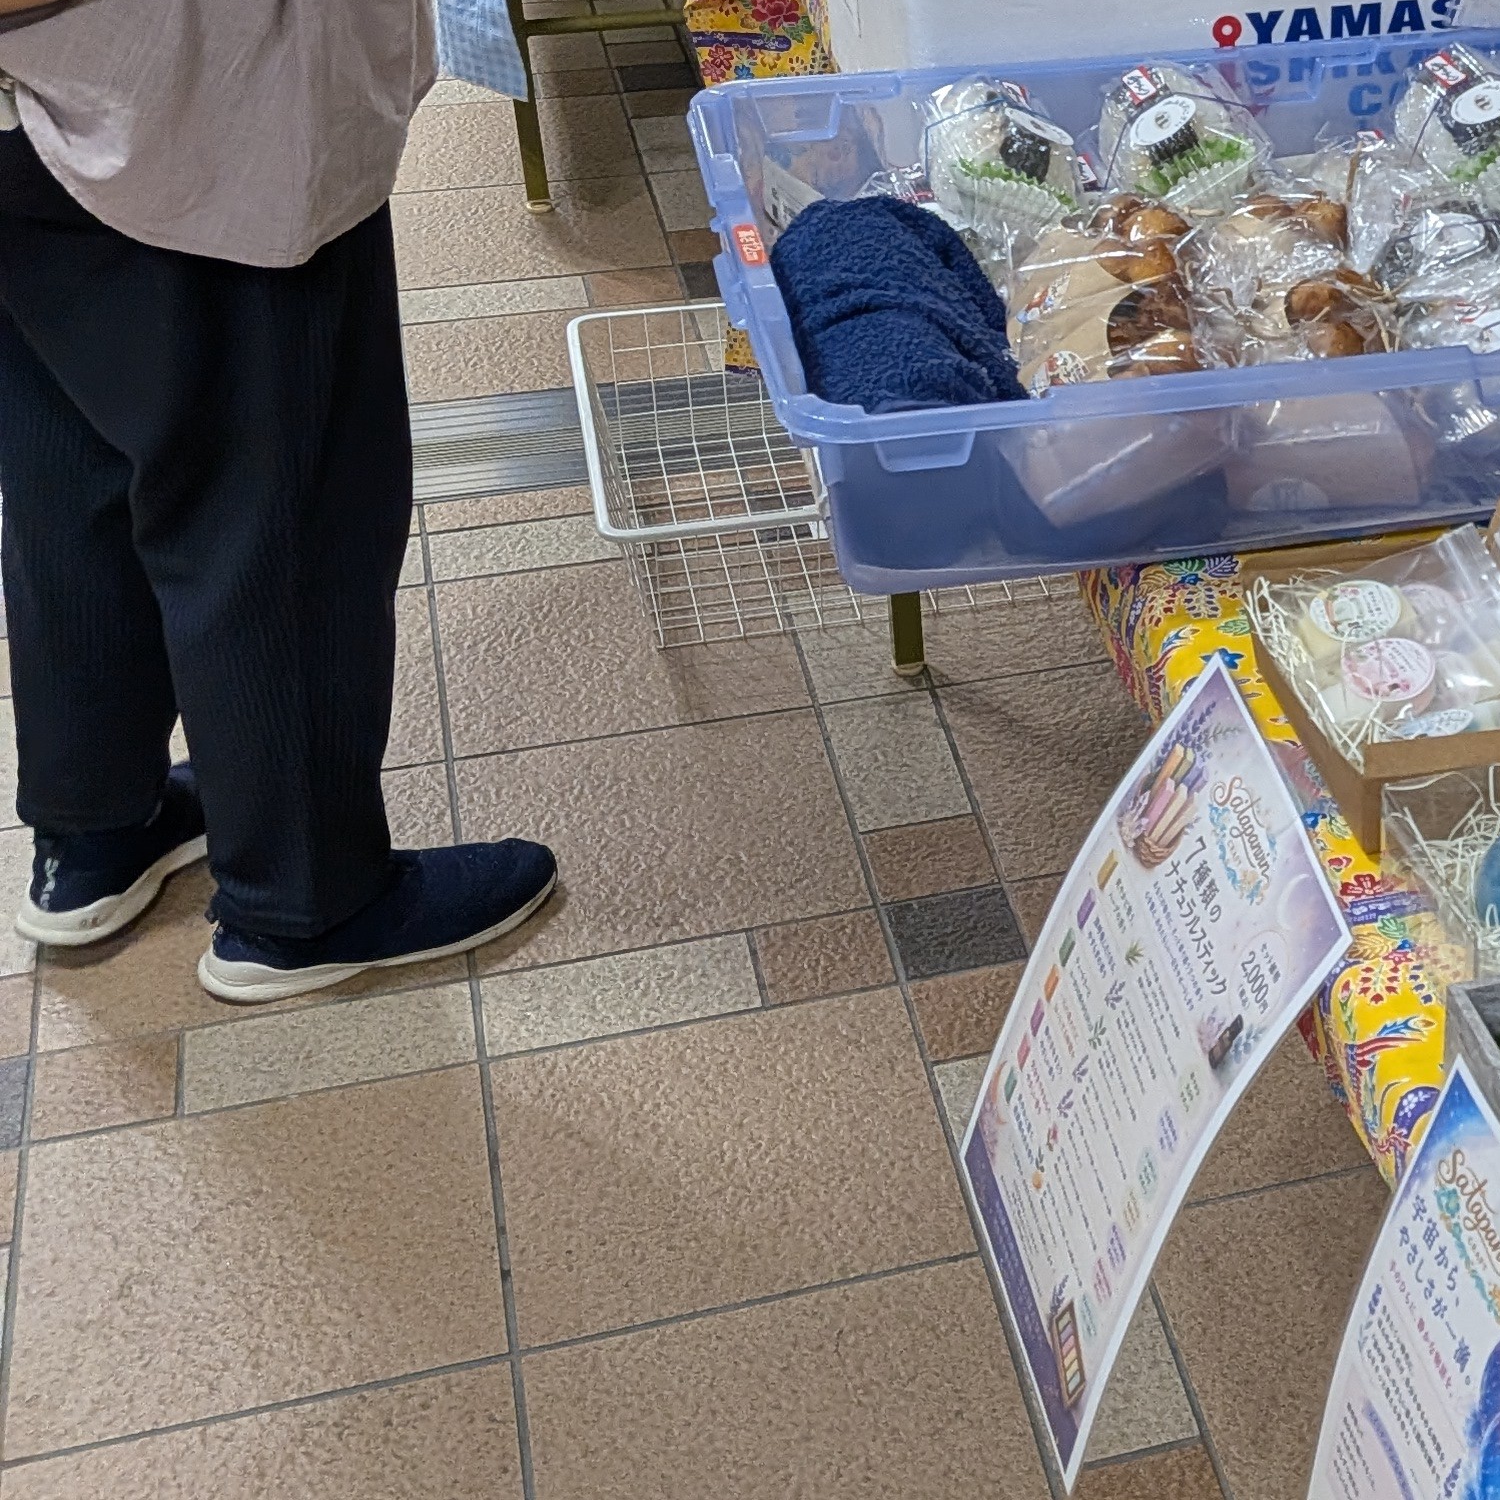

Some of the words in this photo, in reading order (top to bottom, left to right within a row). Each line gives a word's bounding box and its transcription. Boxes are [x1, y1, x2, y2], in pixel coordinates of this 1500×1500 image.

[1164, 859, 1228, 996] ナチュラルスティック
[1184, 835, 1222, 924] 7種類の
[1411, 1194, 1461, 1309] 宇宙から、
